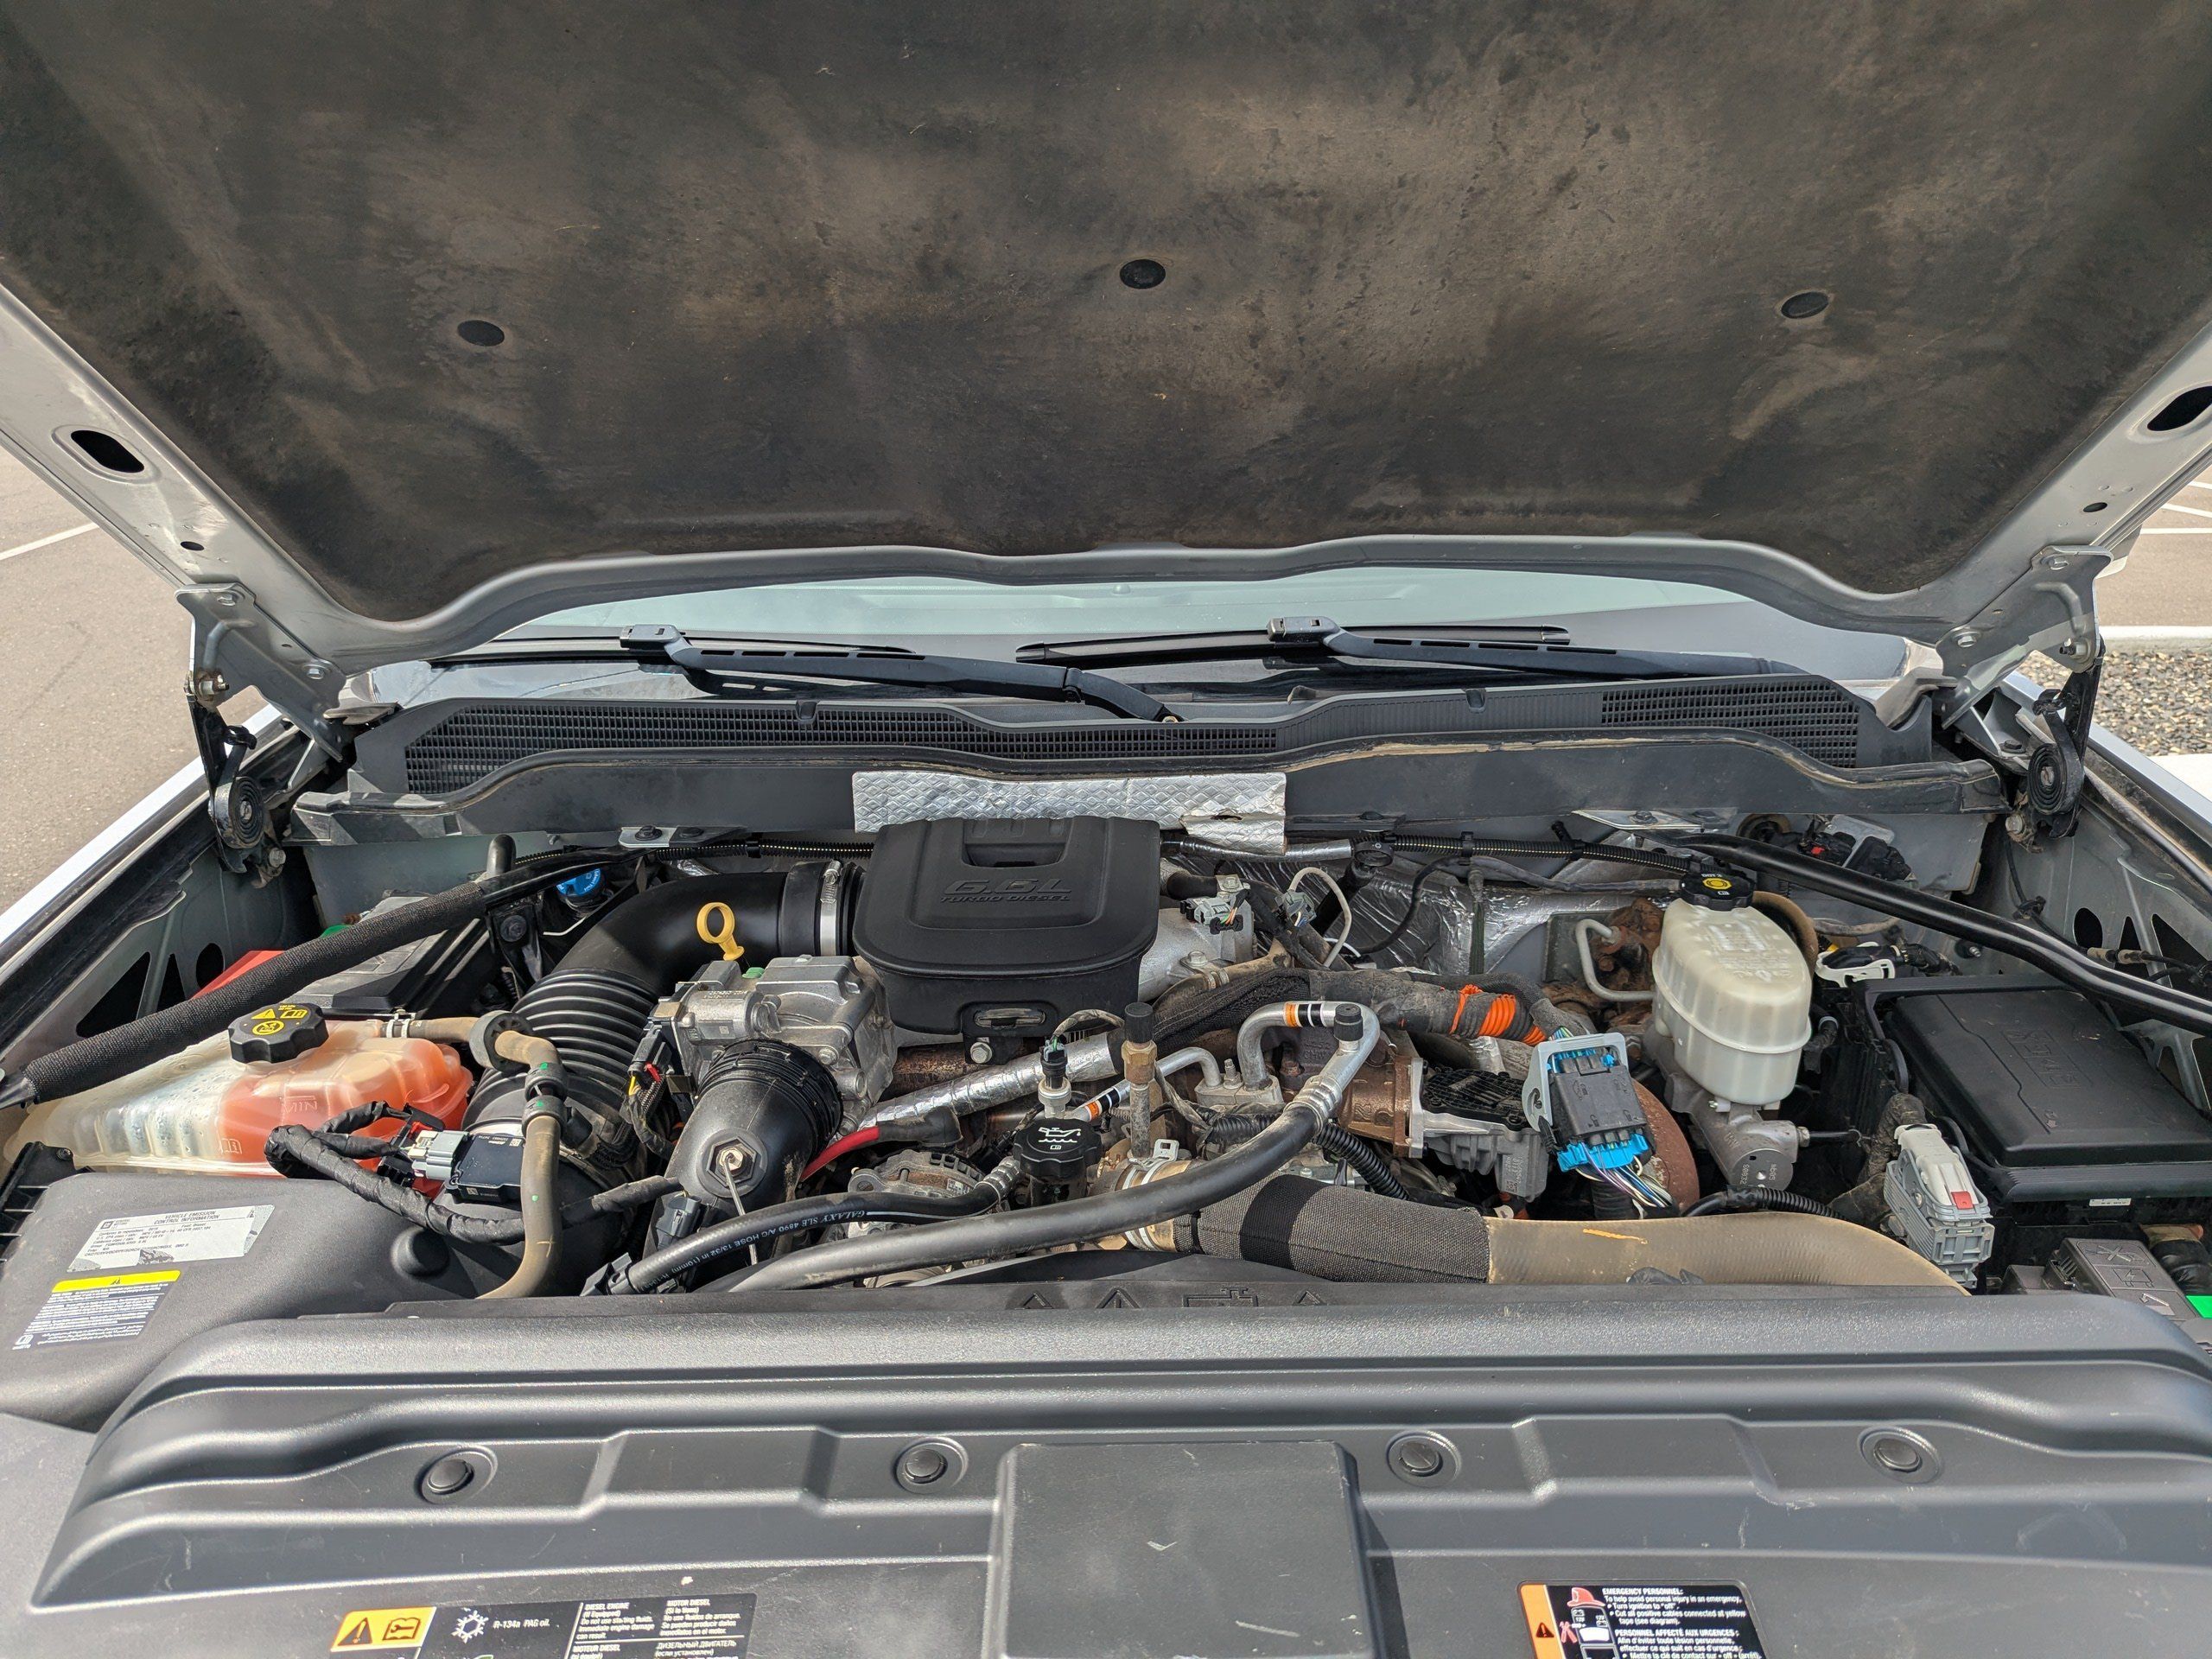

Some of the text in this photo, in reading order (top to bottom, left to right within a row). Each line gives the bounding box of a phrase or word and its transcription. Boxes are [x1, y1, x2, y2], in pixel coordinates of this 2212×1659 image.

[944, 878, 1071, 894] 6.6L
[820, 1210, 865, 1221] GALAXY
[802, 1217, 818, 1227] SLE
[761, 1228, 776, 1238] A/C
[779, 1223, 799, 1233] 4890
[734, 1234, 760, 1244] HOSE
[710, 1244, 732, 1256] 13/32
[671, 1256, 701, 1274] (10mm)
[1725, 1610, 1746, 1618] yellow
[1656, 1628, 1684, 1637] AFFECTÉ
[572, 1644, 600, 1653] MOTEUR
